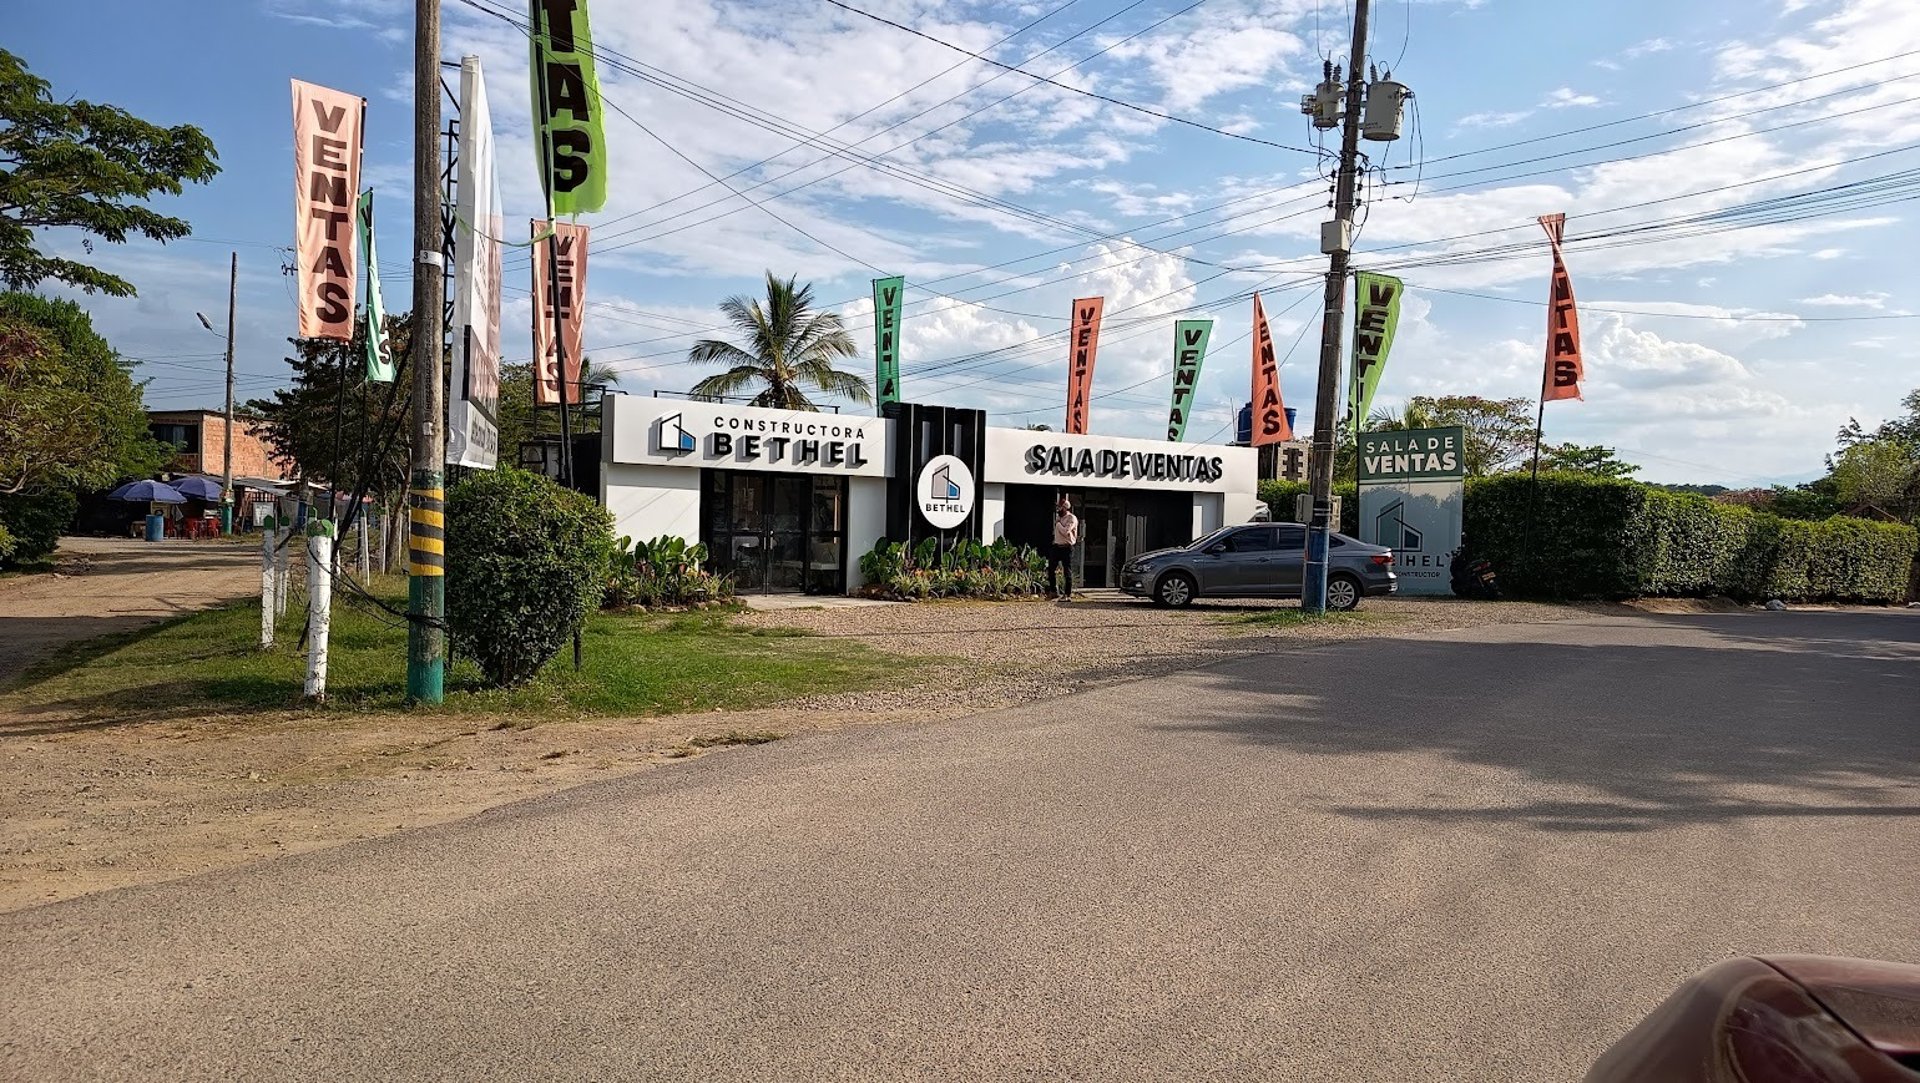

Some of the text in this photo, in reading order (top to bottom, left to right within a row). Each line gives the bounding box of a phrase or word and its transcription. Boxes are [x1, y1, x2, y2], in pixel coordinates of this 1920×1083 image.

[310, 99, 349, 324] VENTAS
[1554, 255, 1577, 387] NTAS
[882, 286, 897, 400] VENTA
[1073, 307, 1095, 434] VENTAS
[1167, 329, 1202, 441] VENTAS
[714, 416, 865, 439] CONSTRUCTORA
[1366, 436, 1454, 453] SALA DE
[712, 432, 868, 466] BETHEL
[1029, 444, 1223, 481] SALA DE VENTAS
[1364, 452, 1456, 474] VENTAS
[925, 503, 966, 513] BETHEL
